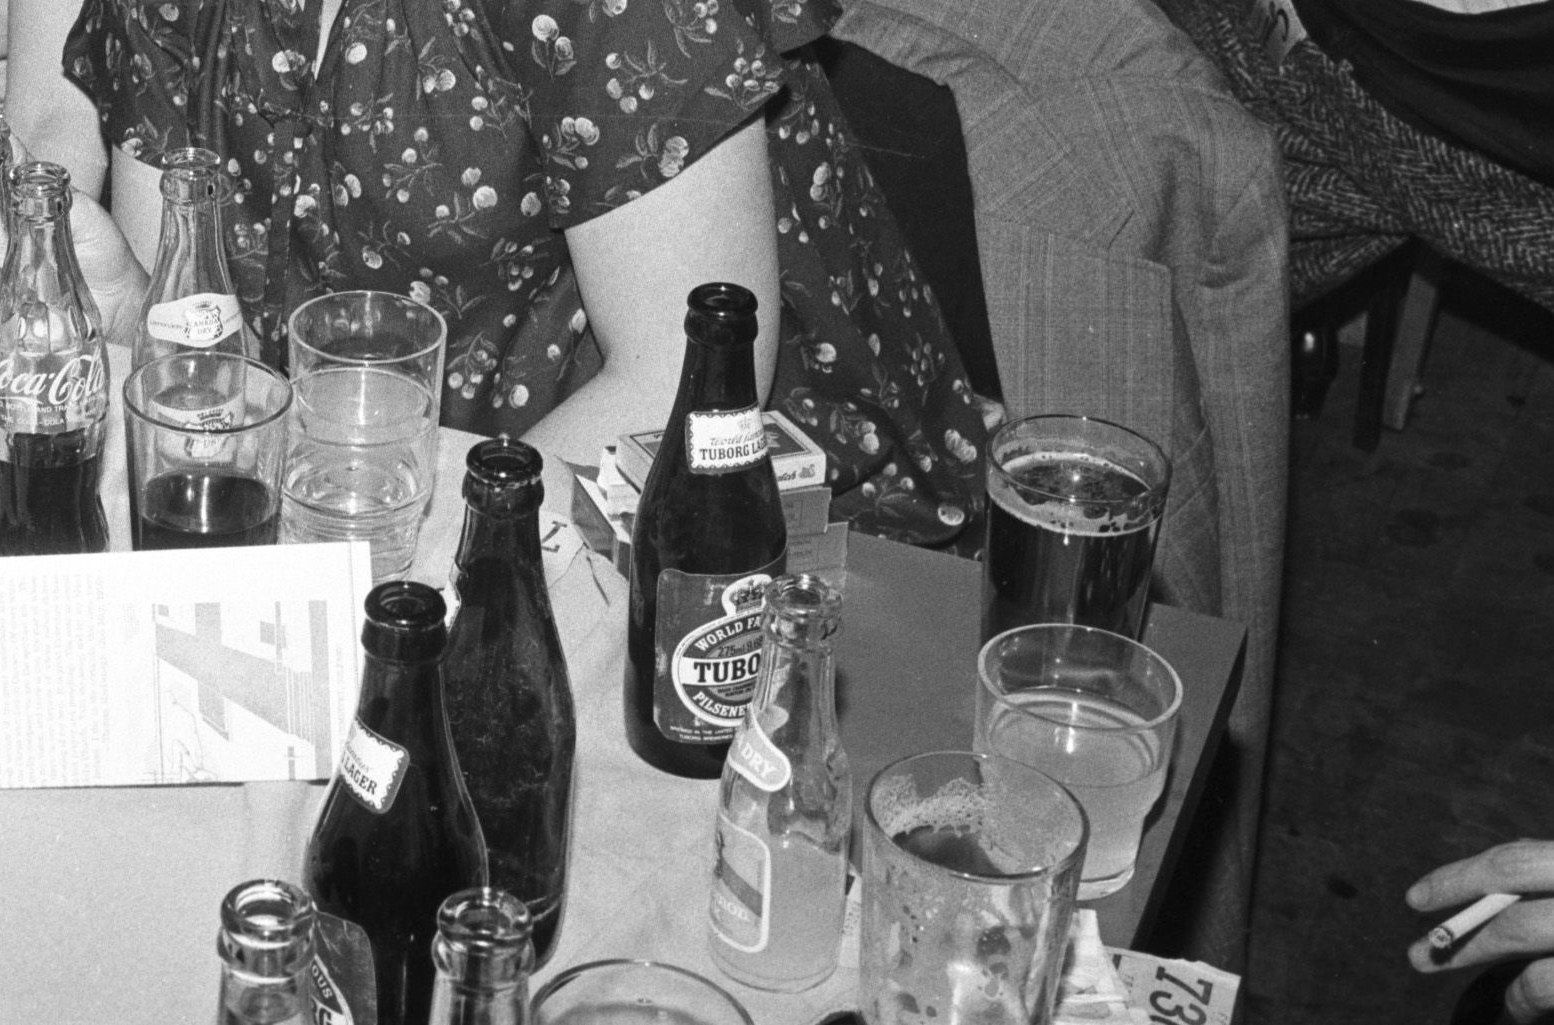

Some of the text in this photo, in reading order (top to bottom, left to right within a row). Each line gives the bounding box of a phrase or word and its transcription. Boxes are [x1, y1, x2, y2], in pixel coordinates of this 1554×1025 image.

[699, 444, 750, 461] TUBORG
[694, 621, 744, 652] WORLD
[693, 652, 761, 683] TUBO
[344, 756, 377, 795] LAGER
[741, 742, 778, 778] DRY
